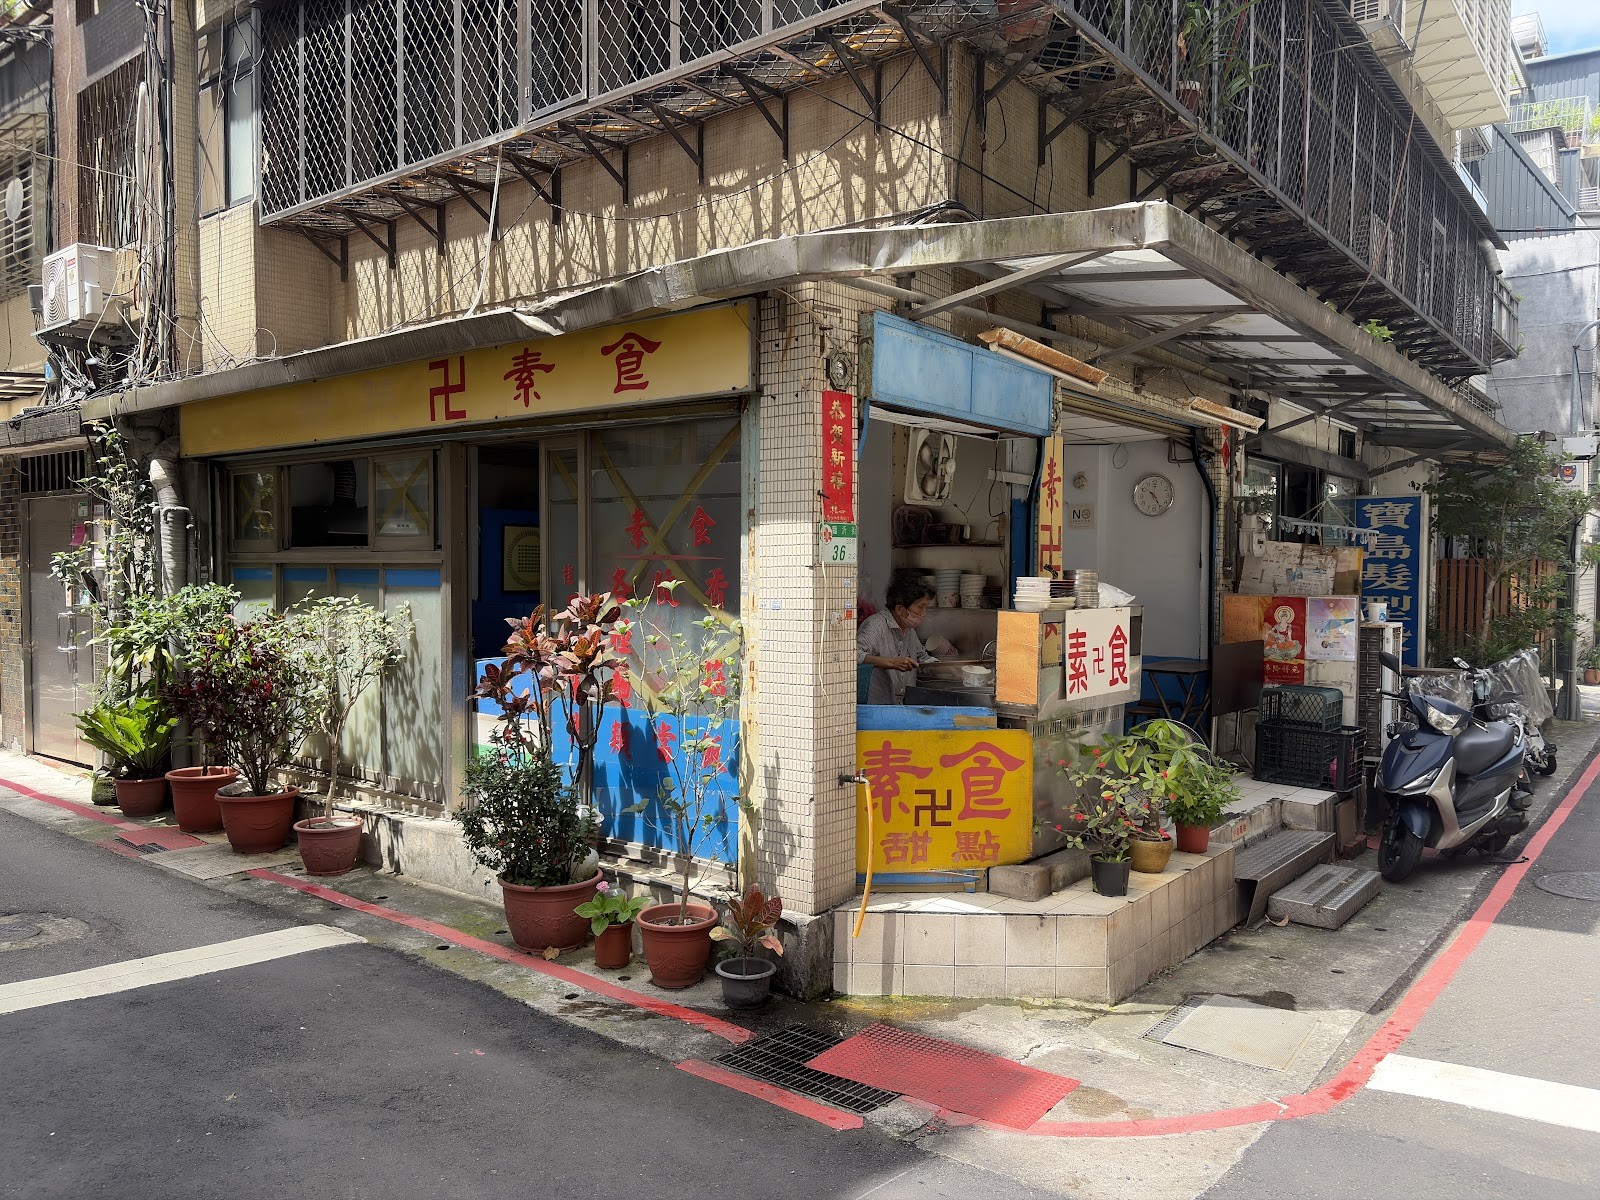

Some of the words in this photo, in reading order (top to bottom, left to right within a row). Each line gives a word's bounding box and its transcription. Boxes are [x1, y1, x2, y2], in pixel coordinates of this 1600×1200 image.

[829, 399, 847, 491] 恭賀新禧
[832, 544, 846, 561] 36
[1361, 501, 1413, 669] 寶島髮型
[880, 829, 1001, 865] 甜點
